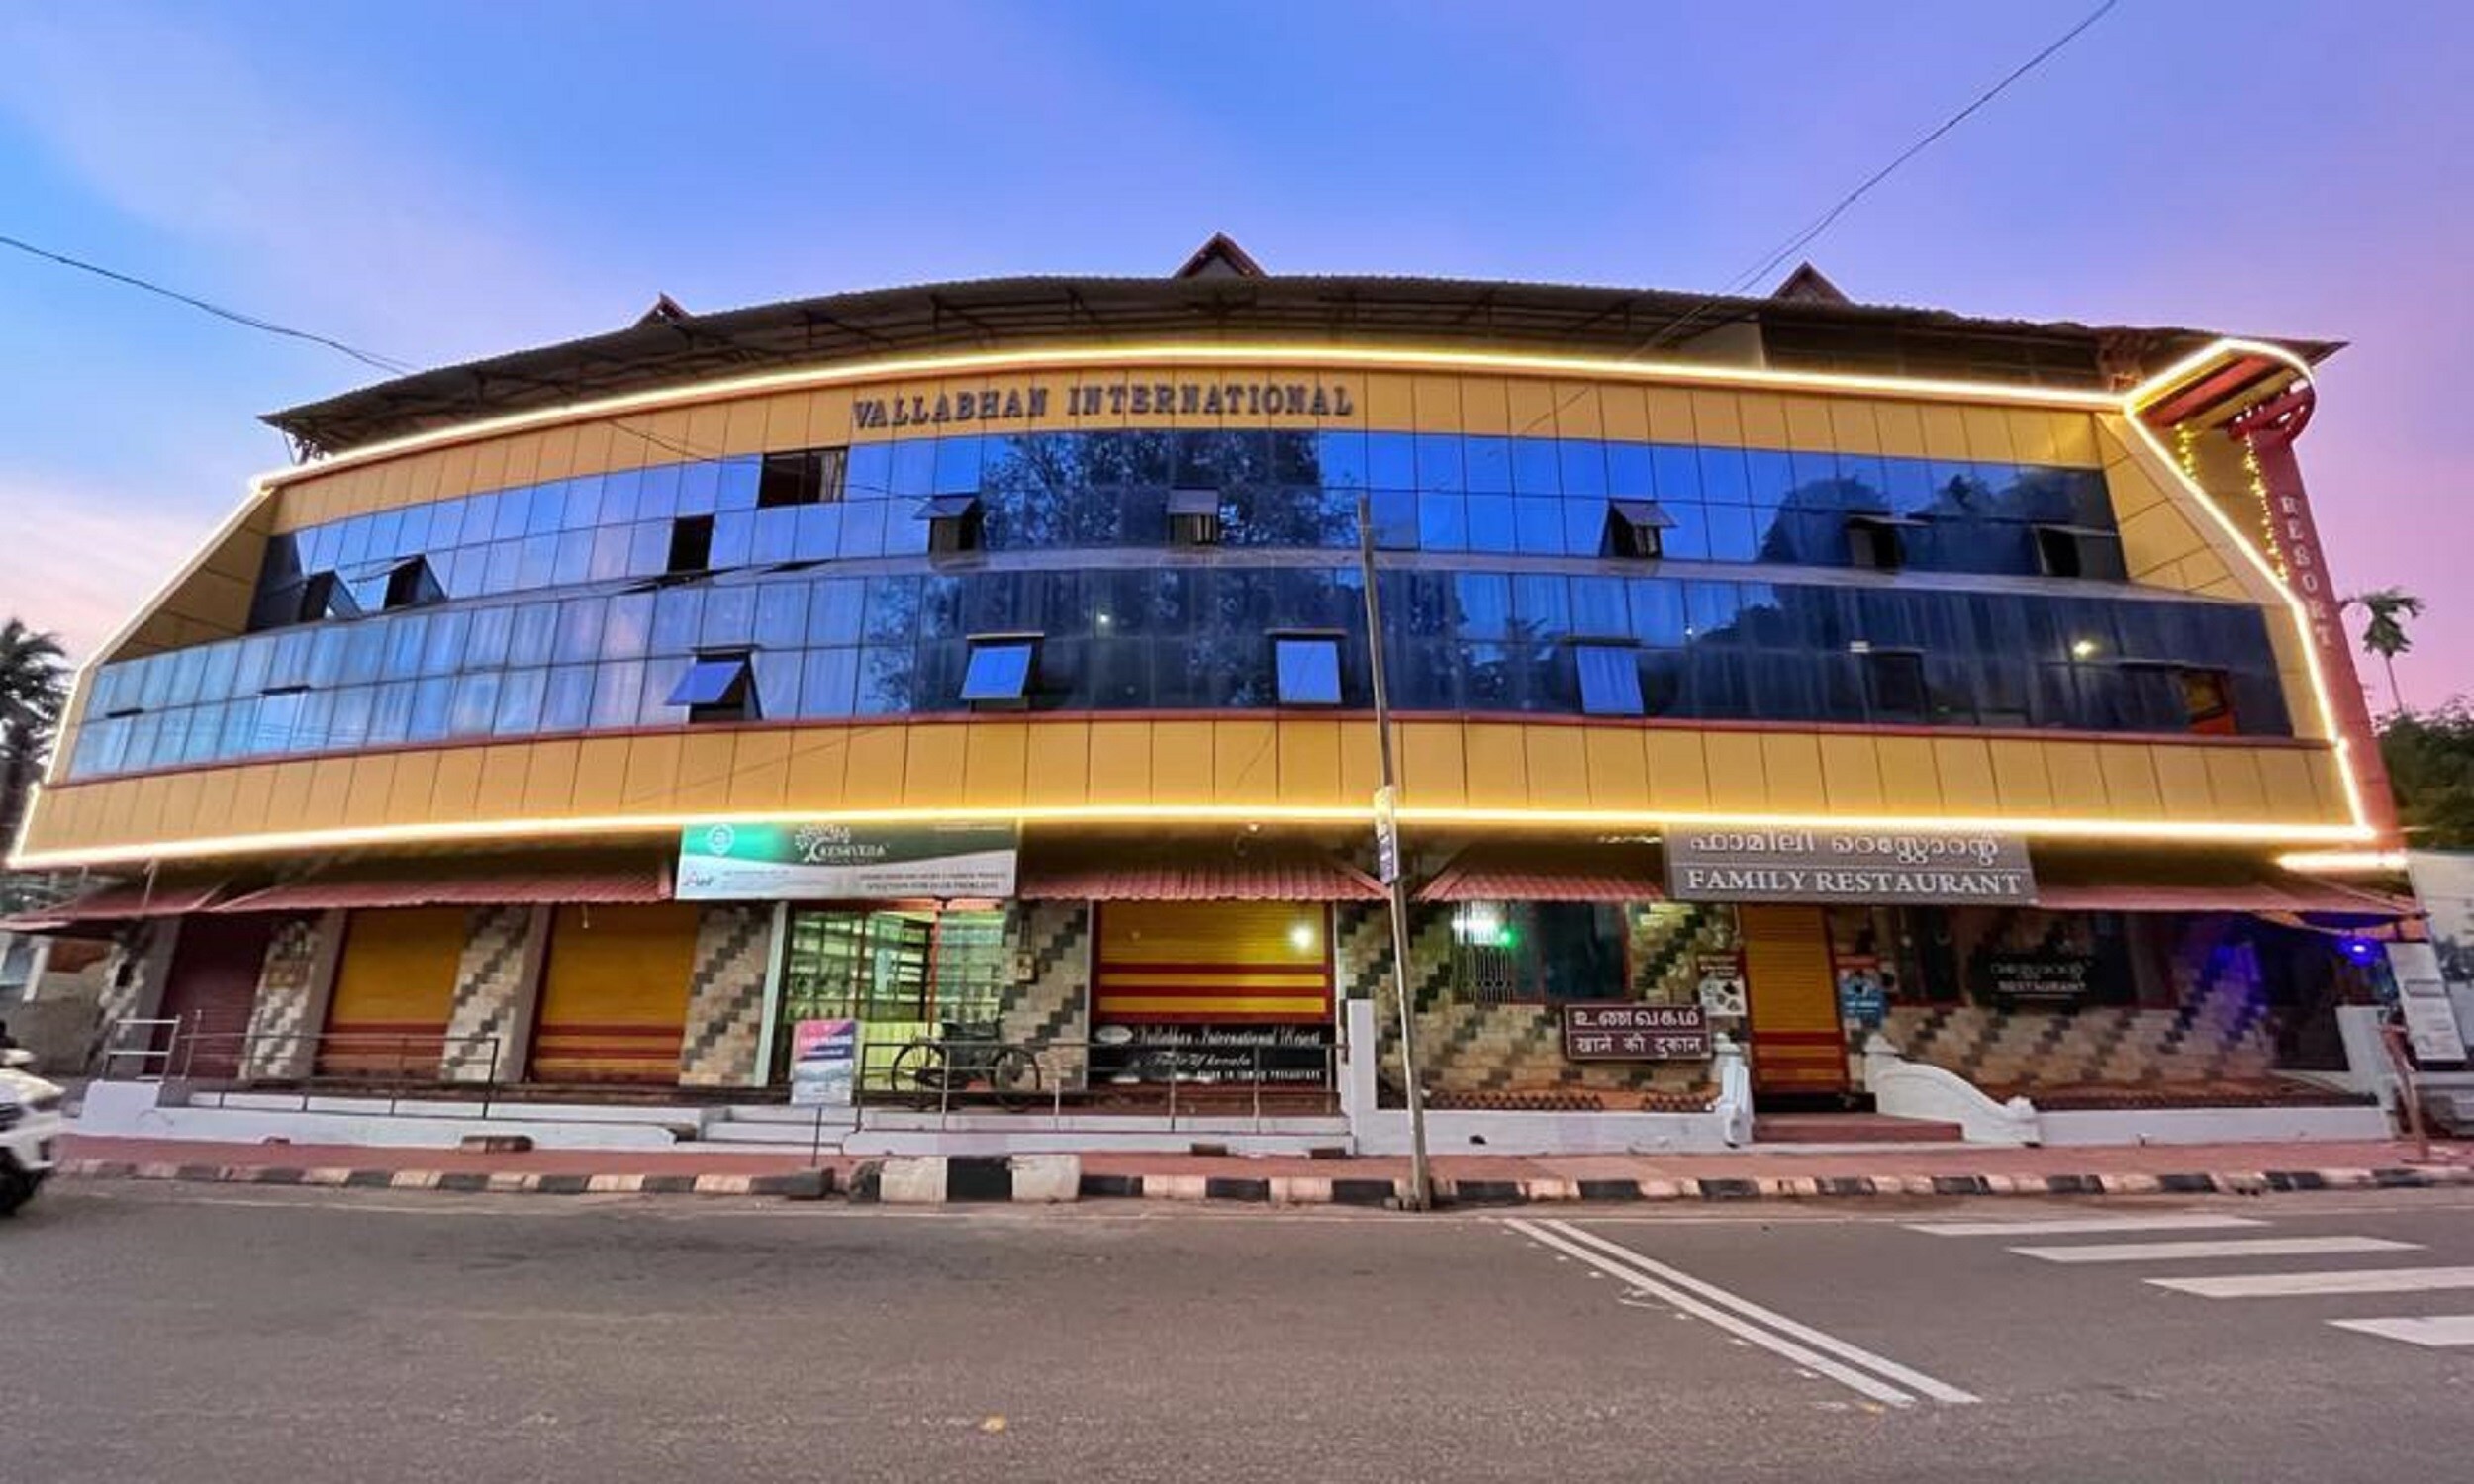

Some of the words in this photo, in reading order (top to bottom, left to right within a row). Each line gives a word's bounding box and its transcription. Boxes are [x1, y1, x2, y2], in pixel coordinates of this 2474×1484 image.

[853, 388, 1049, 429] VALLABHAN
[1067, 383, 1355, 417] INTERNATIONAL
[1690, 829, 1815, 852] ഫാമിലി
[1688, 869, 1807, 890] FAMILY
[1814, 871, 2021, 895] RESTAURANT
[1573, 1004, 1699, 1026] உணவகம்
[1575, 1034, 1613, 1052] खाने
[1623, 1032, 1646, 1052] की
[1653, 1037, 1702, 1059] दुकान
